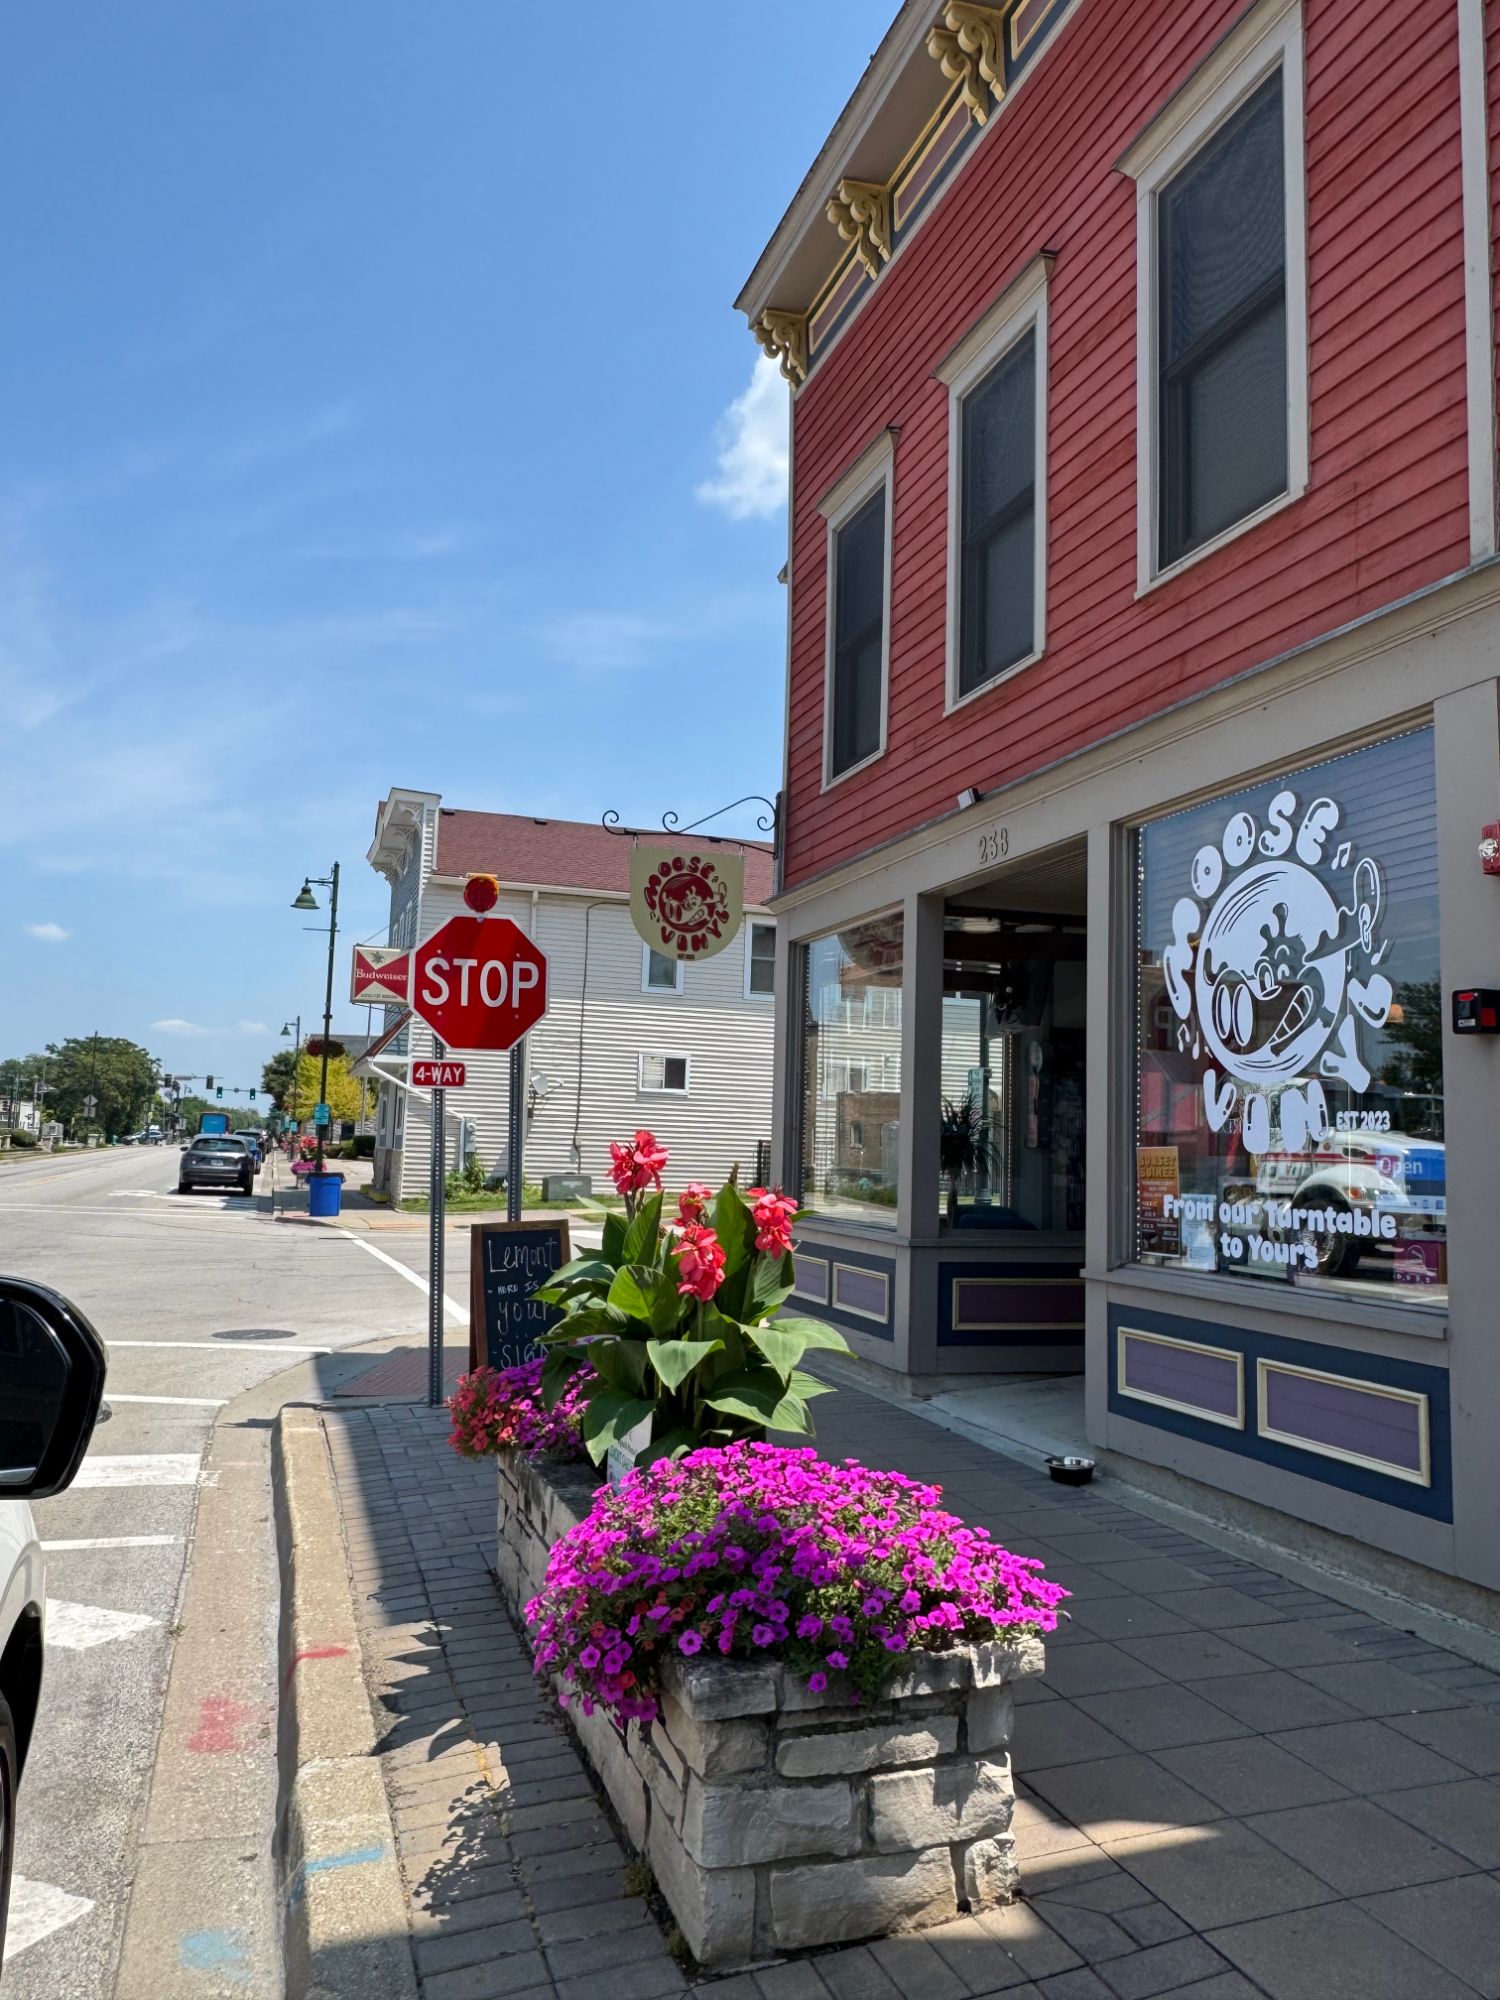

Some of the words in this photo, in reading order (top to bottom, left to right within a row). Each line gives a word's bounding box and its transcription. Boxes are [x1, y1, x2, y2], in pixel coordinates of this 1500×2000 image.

[644, 856, 715, 910] MOOSE
[1163, 790, 1339, 1020] MOOSE
[661, 910, 730, 952] VINYL
[356, 968, 408, 980] Budweiser
[422, 957, 539, 1008] STOP
[415, 1066, 463, 1083] 4-WAY
[1203, 973, 1393, 1155] VINYL
[1336, 1110, 1359, 1131] EST
[1360, 1110, 1391, 1131] 2023
[1379, 1157, 1423, 1178] Open
[1163, 1194, 1214, 1221] From
[1219, 1202, 1259, 1225] our
[1263, 1200, 1397, 1239] Turntable
[1220, 1232, 1243, 1258] to
[1247, 1234, 1319, 1268] Yours
